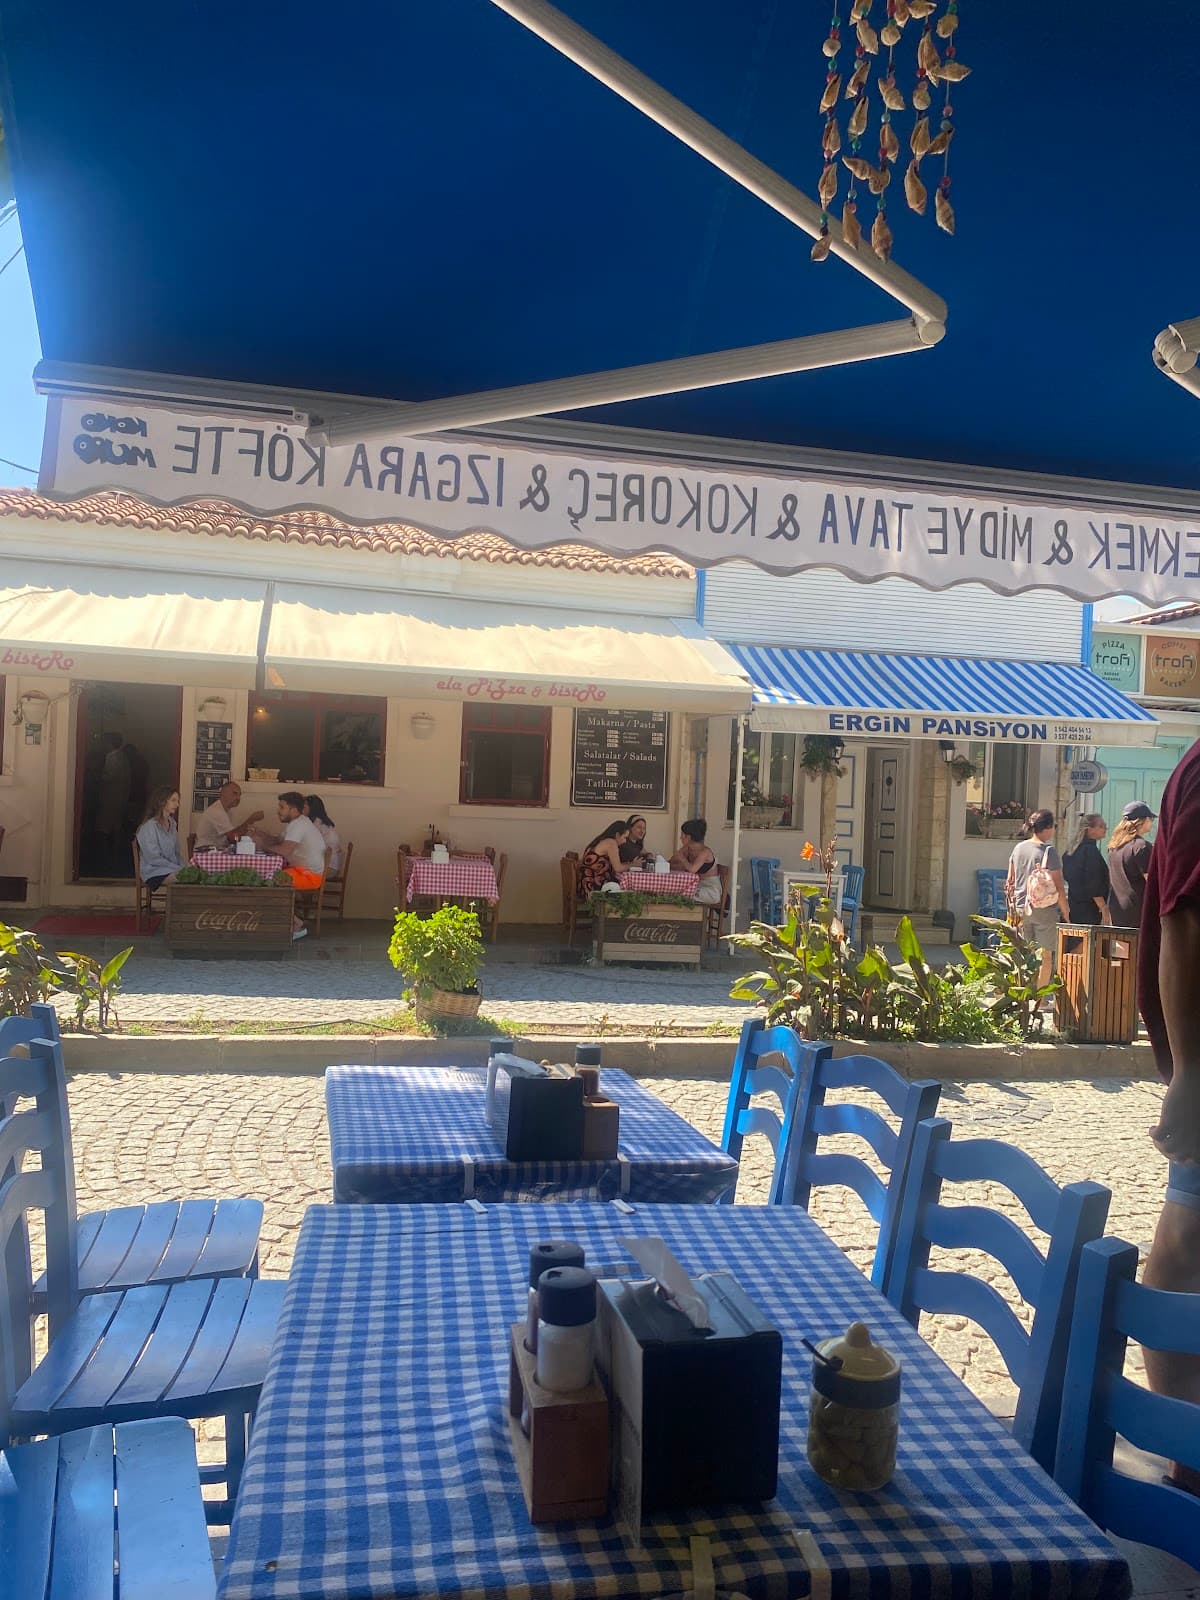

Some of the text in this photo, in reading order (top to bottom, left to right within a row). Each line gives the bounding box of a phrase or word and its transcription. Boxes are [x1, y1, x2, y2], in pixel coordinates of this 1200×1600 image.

[436, 676, 463, 691] ela
[633, 720, 656, 729] Pasta
[583, 750, 621, 760] Salatalar
[630, 752, 657, 761] Salads
[625, 780, 653, 790] Desert
